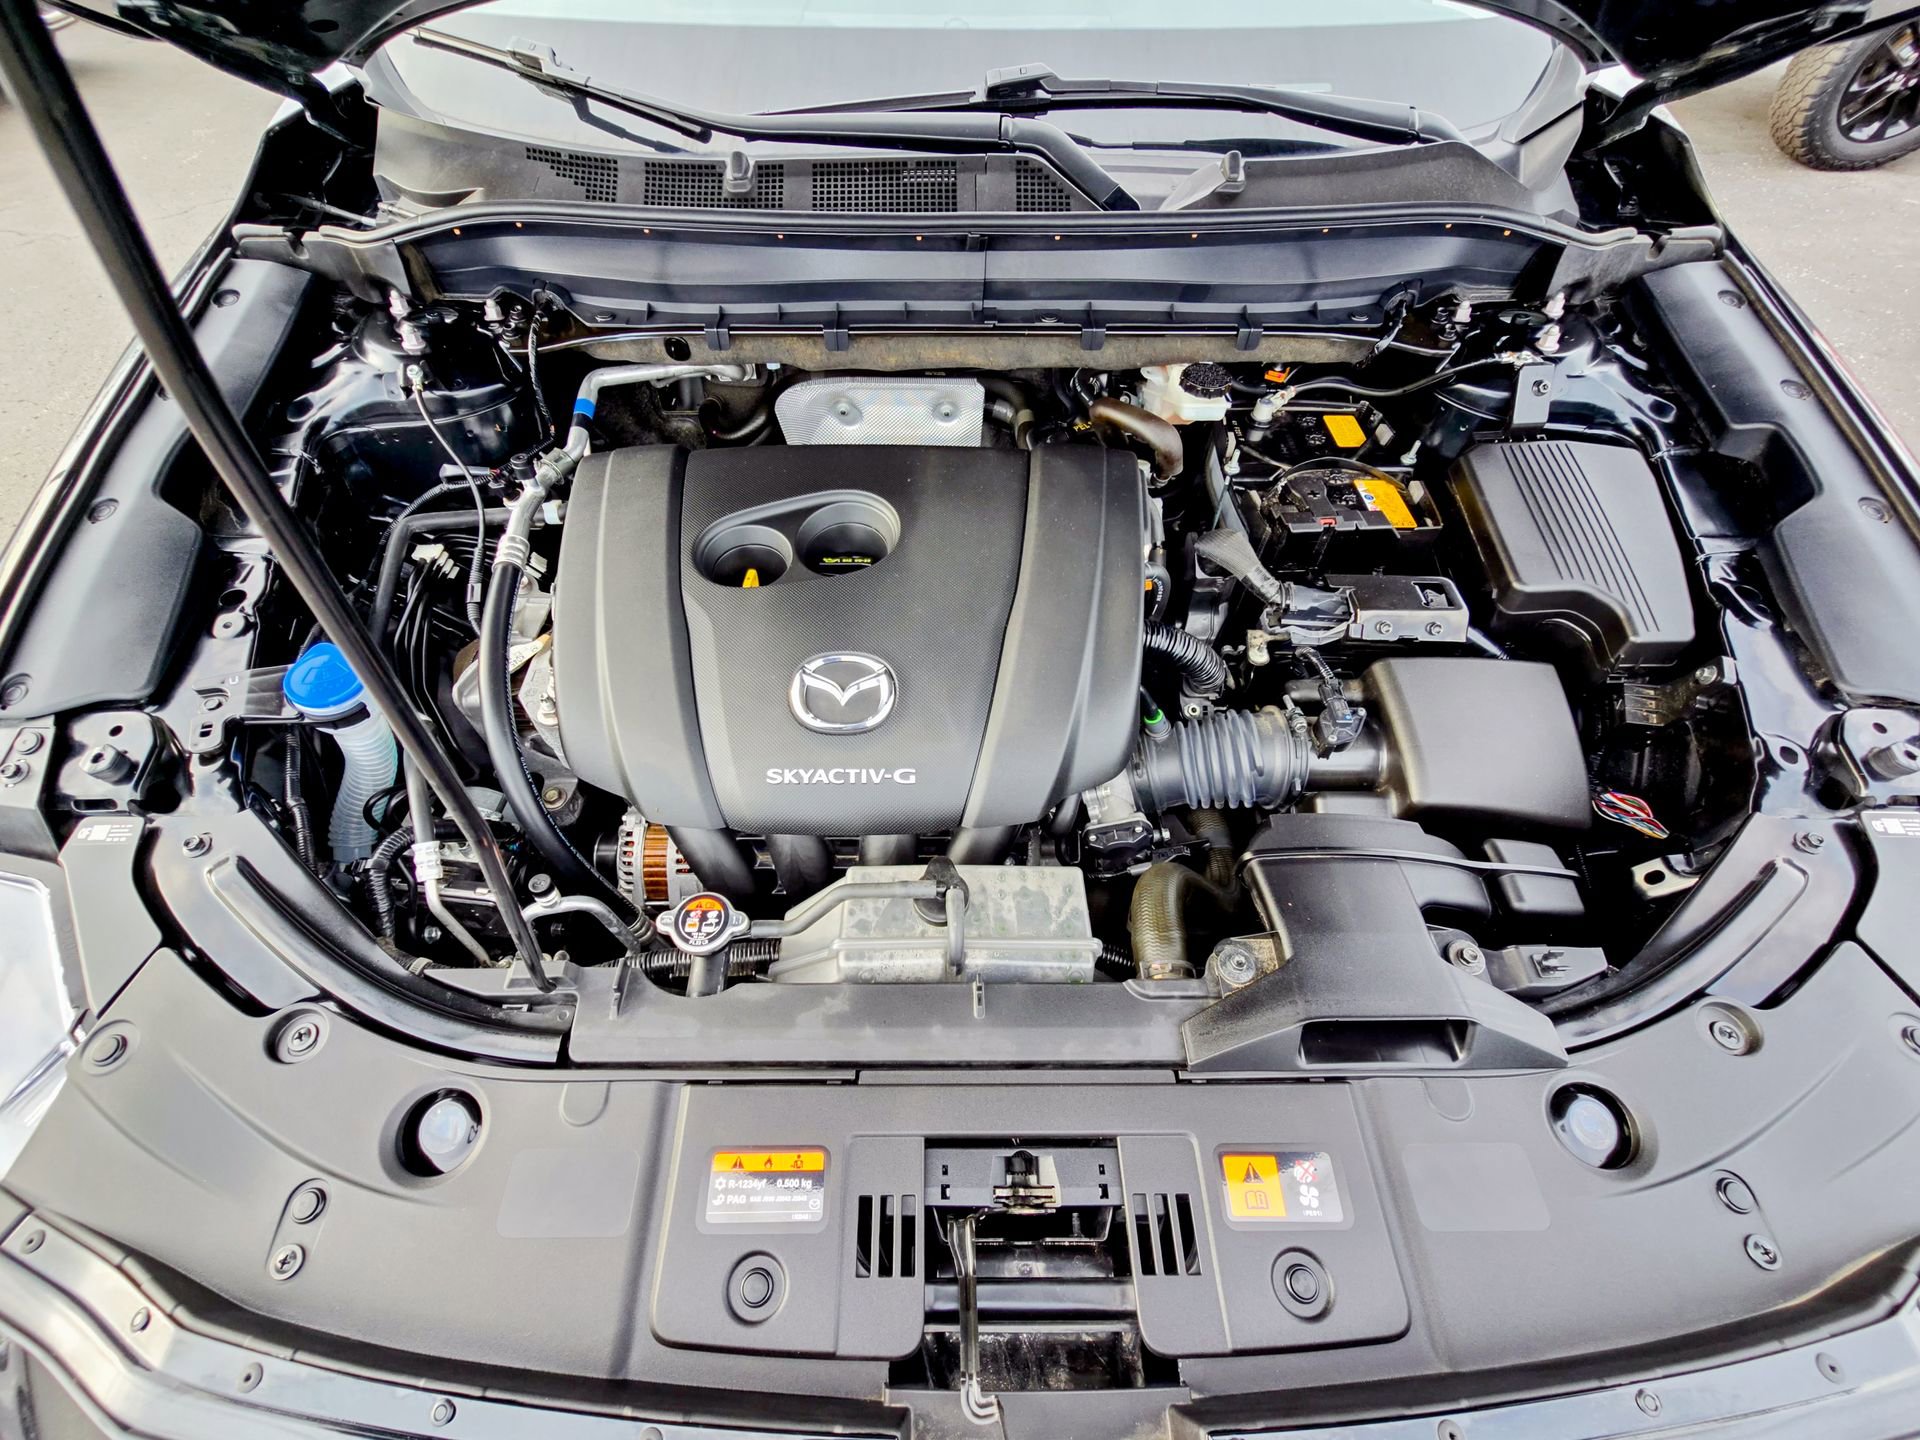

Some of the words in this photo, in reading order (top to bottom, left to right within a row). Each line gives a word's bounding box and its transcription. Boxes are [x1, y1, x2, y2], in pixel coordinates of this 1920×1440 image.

[766, 768, 917, 784] SKYACTIV-G
[728, 1178, 767, 1191] R-1234yf
[776, 1178, 800, 1189] 0.500
[801, 1177, 813, 1190] kg
[727, 1195, 747, 1204] PAG
